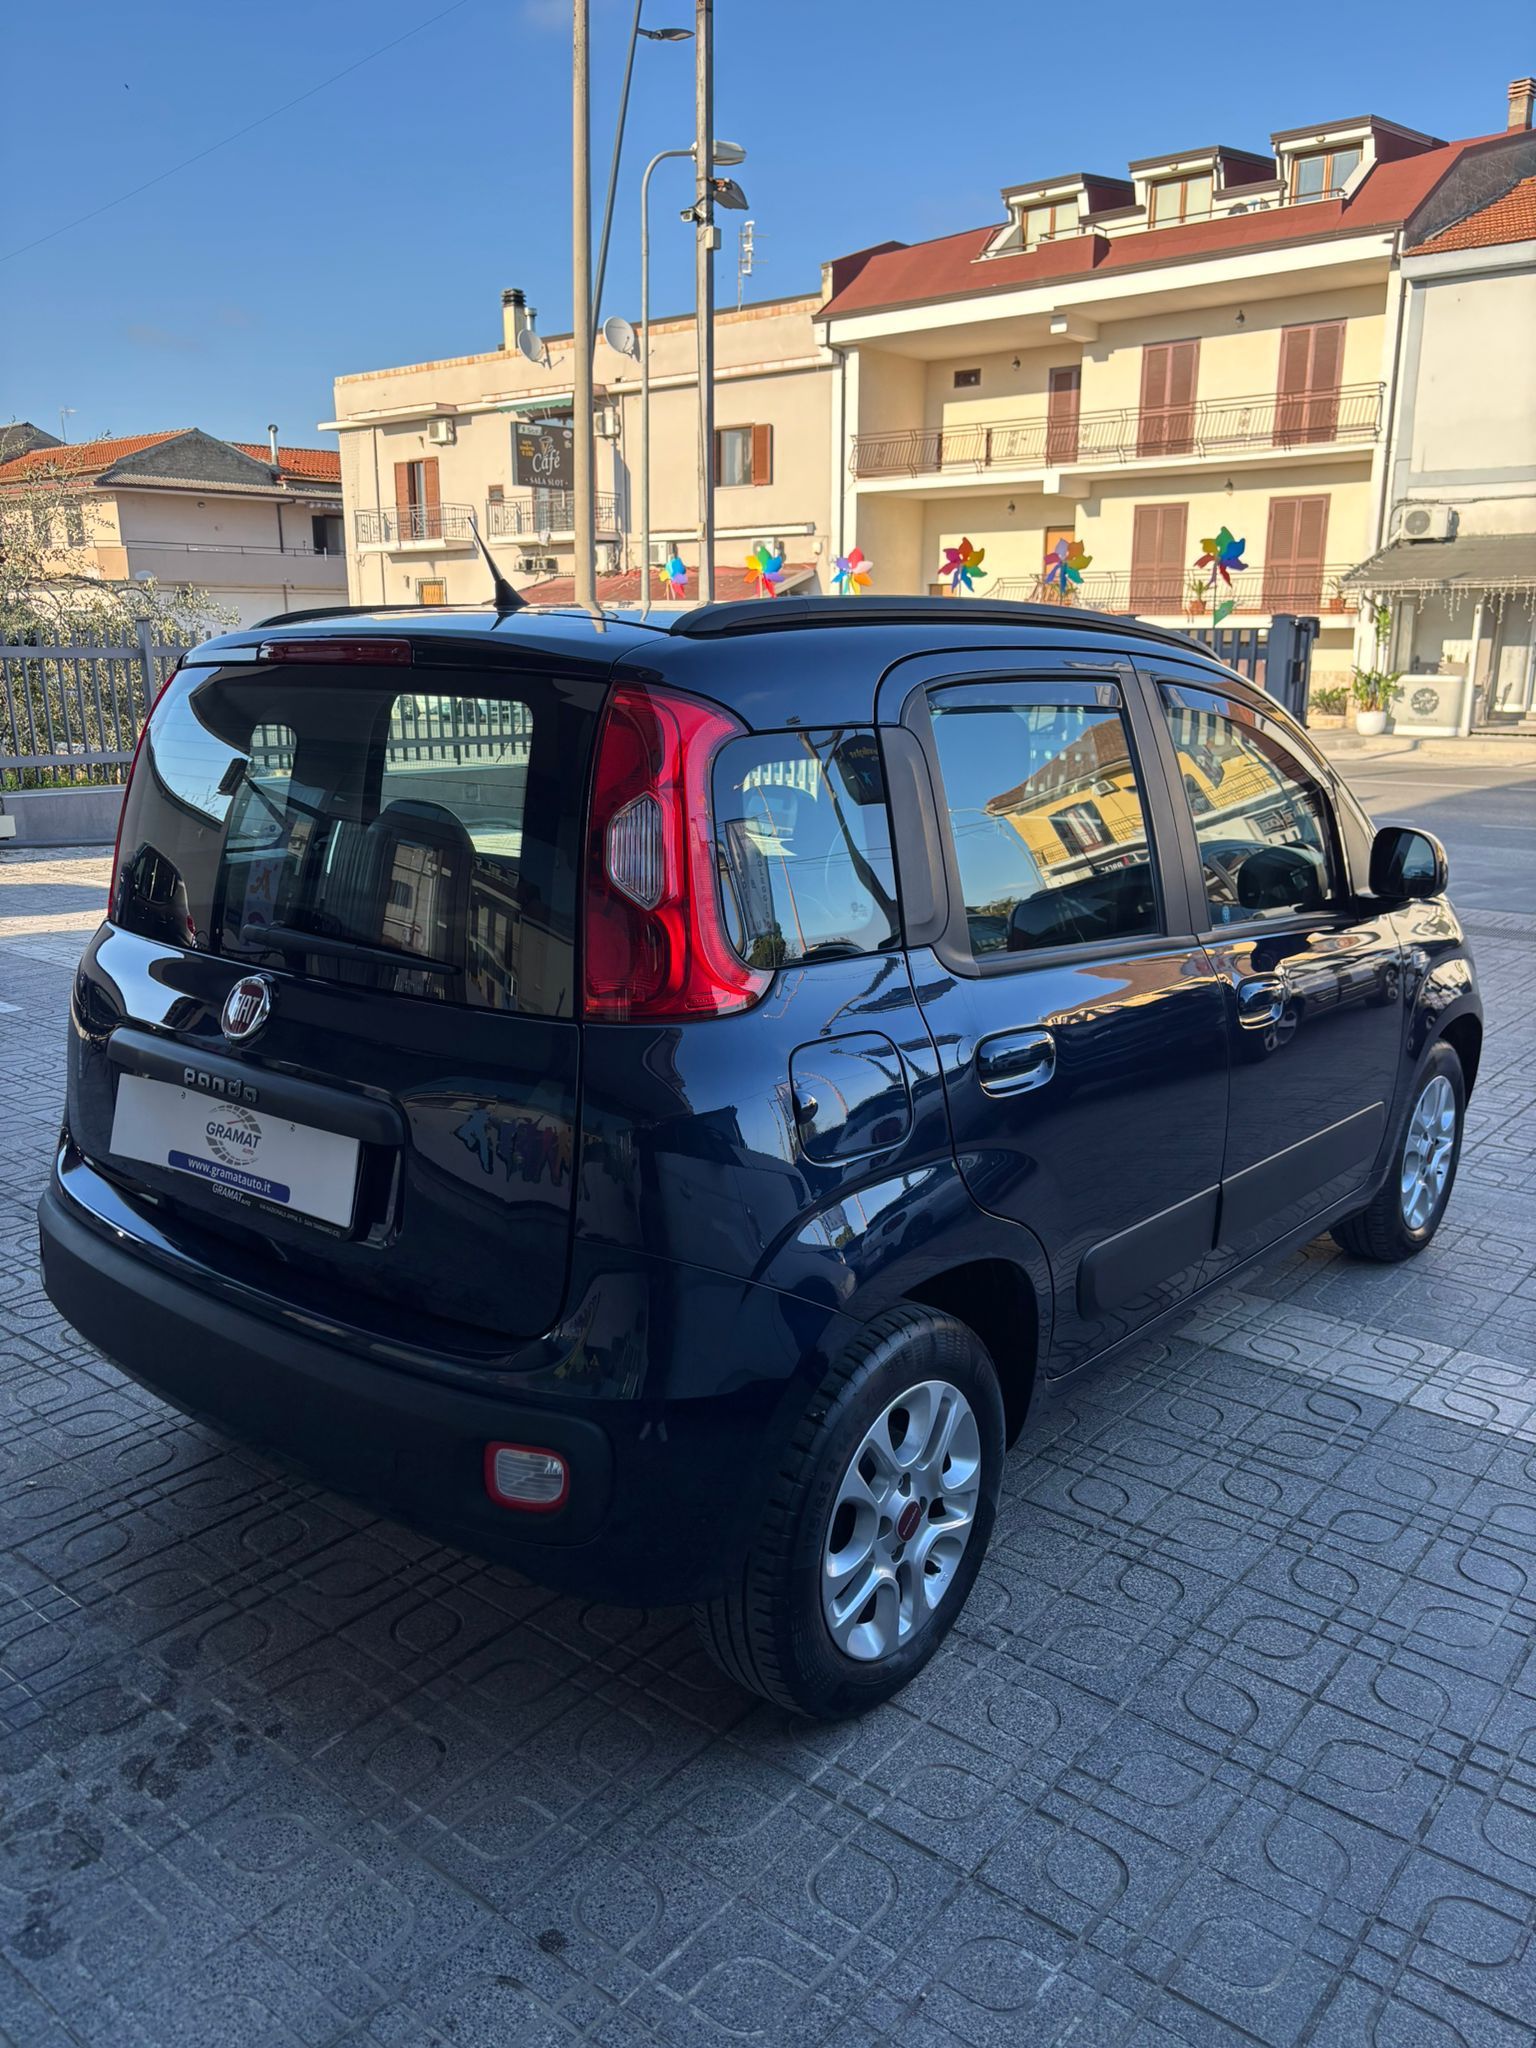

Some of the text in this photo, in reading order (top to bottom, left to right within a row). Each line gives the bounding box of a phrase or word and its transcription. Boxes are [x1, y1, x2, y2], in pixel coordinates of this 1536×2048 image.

[532, 449, 561, 475] Café
[530, 476, 547, 486] SALA
[206, 1121, 262, 1149] GRAMAT
[187, 1158, 272, 1194] www.gramatauto.it
[212, 1183, 243, 1202] GRAMAT
